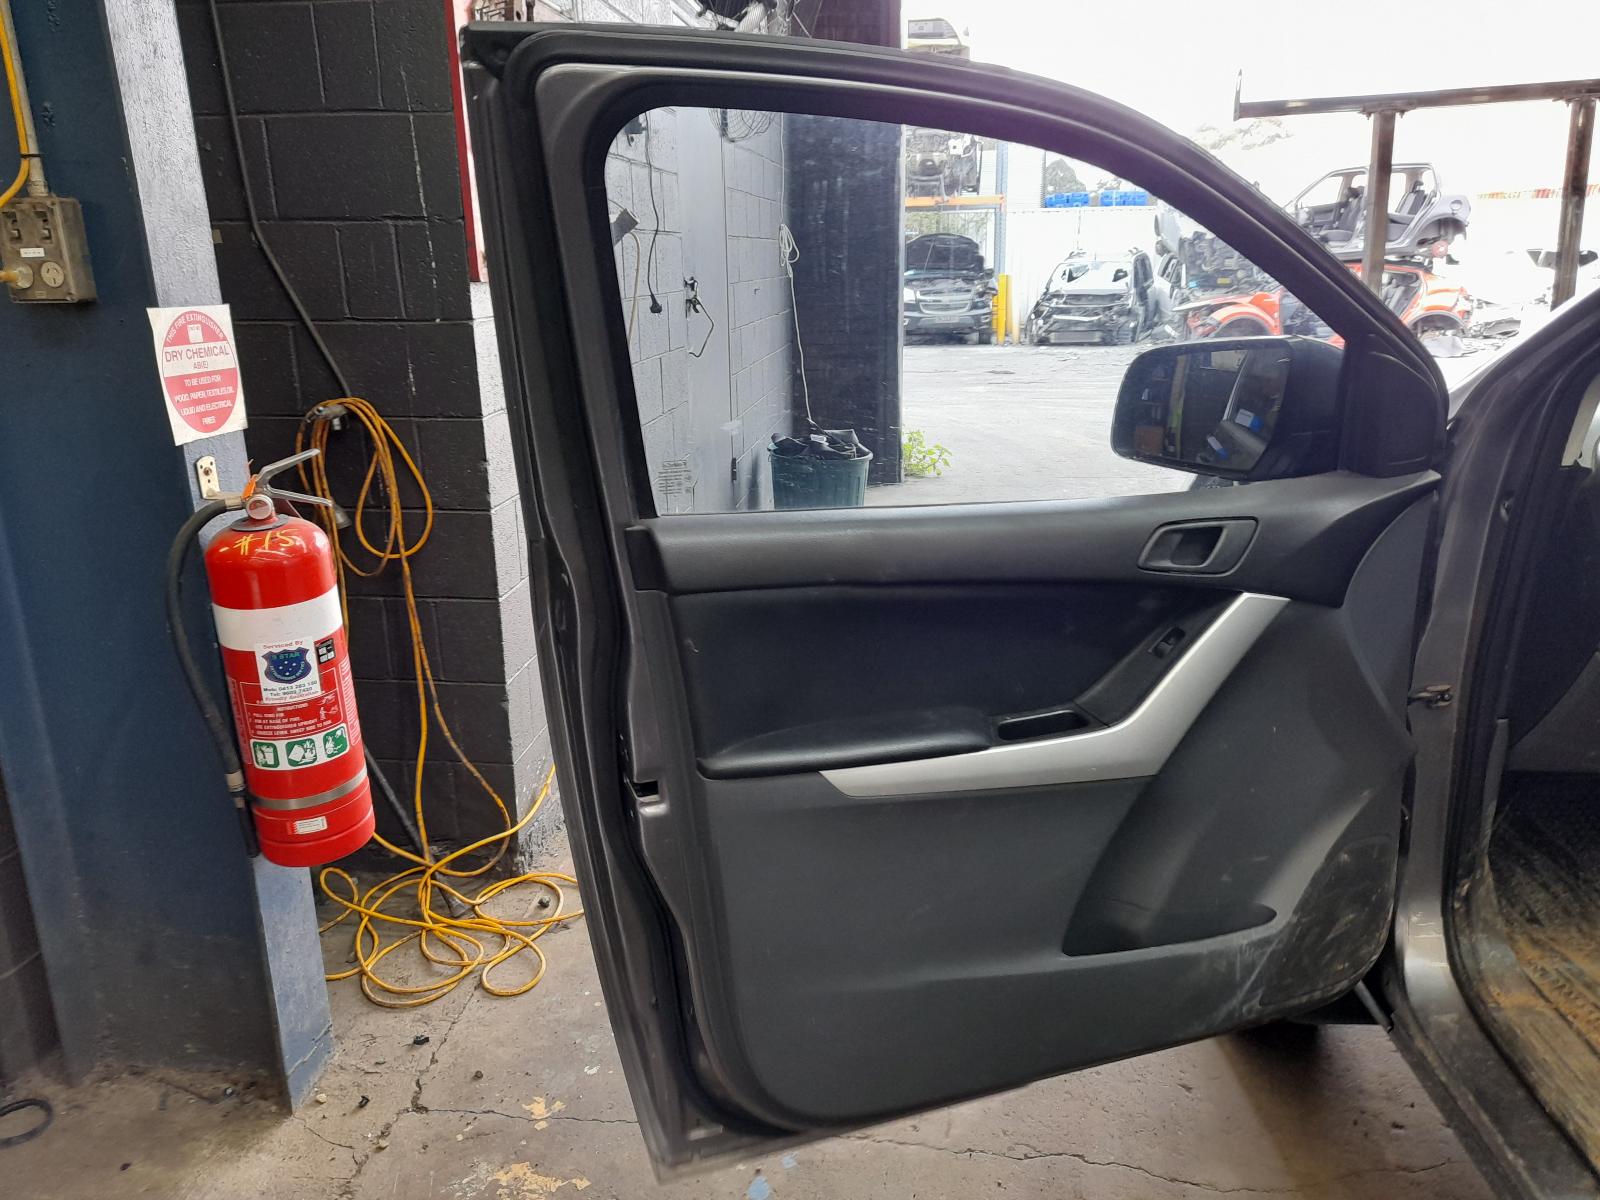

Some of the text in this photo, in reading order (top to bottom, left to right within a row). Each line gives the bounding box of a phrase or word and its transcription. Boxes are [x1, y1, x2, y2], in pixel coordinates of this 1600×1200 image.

[175, 316, 187, 329] FIRE
[186, 313, 224, 340] EXTINGUISHER
[165, 345, 230, 362] DRY CHEMICAL
[192, 378, 199, 386] BE
[199, 376, 211, 385] USED
[211, 375, 221, 383] FOR
[180, 400, 232, 416] LIQUID AND ELECTRICAL
[202, 416, 216, 424] FIRES
[279, 652, 301, 660] STAR
